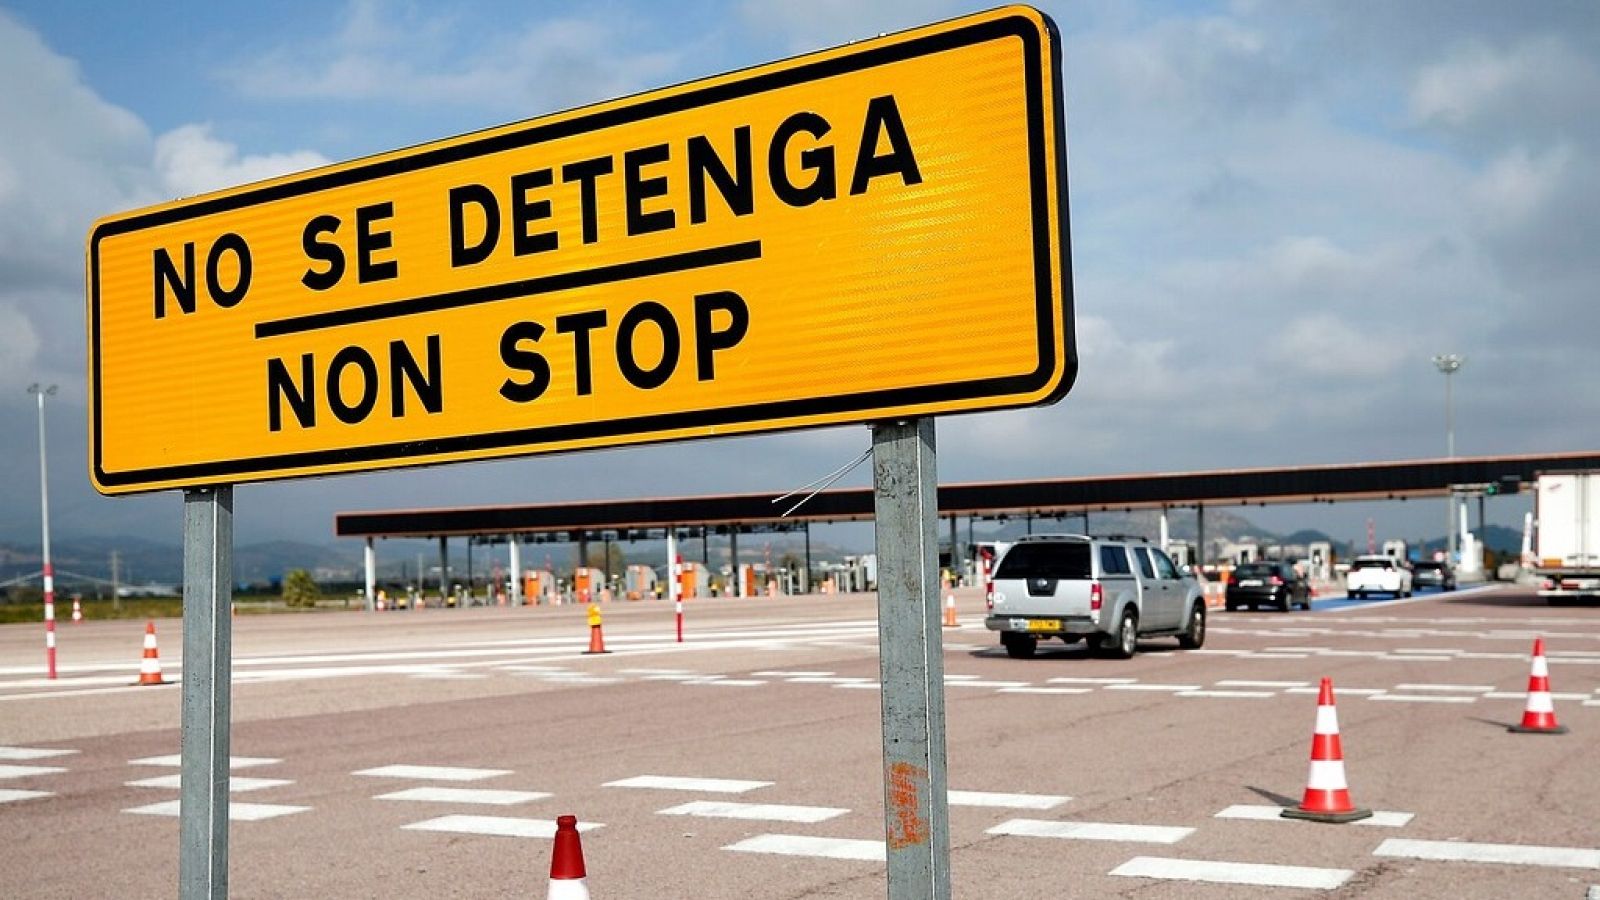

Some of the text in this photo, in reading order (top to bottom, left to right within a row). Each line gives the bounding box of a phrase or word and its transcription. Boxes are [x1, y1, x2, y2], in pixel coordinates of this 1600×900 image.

[155, 95, 922, 319] NO SE DETENGA
[269, 291, 748, 431] NON STOP
